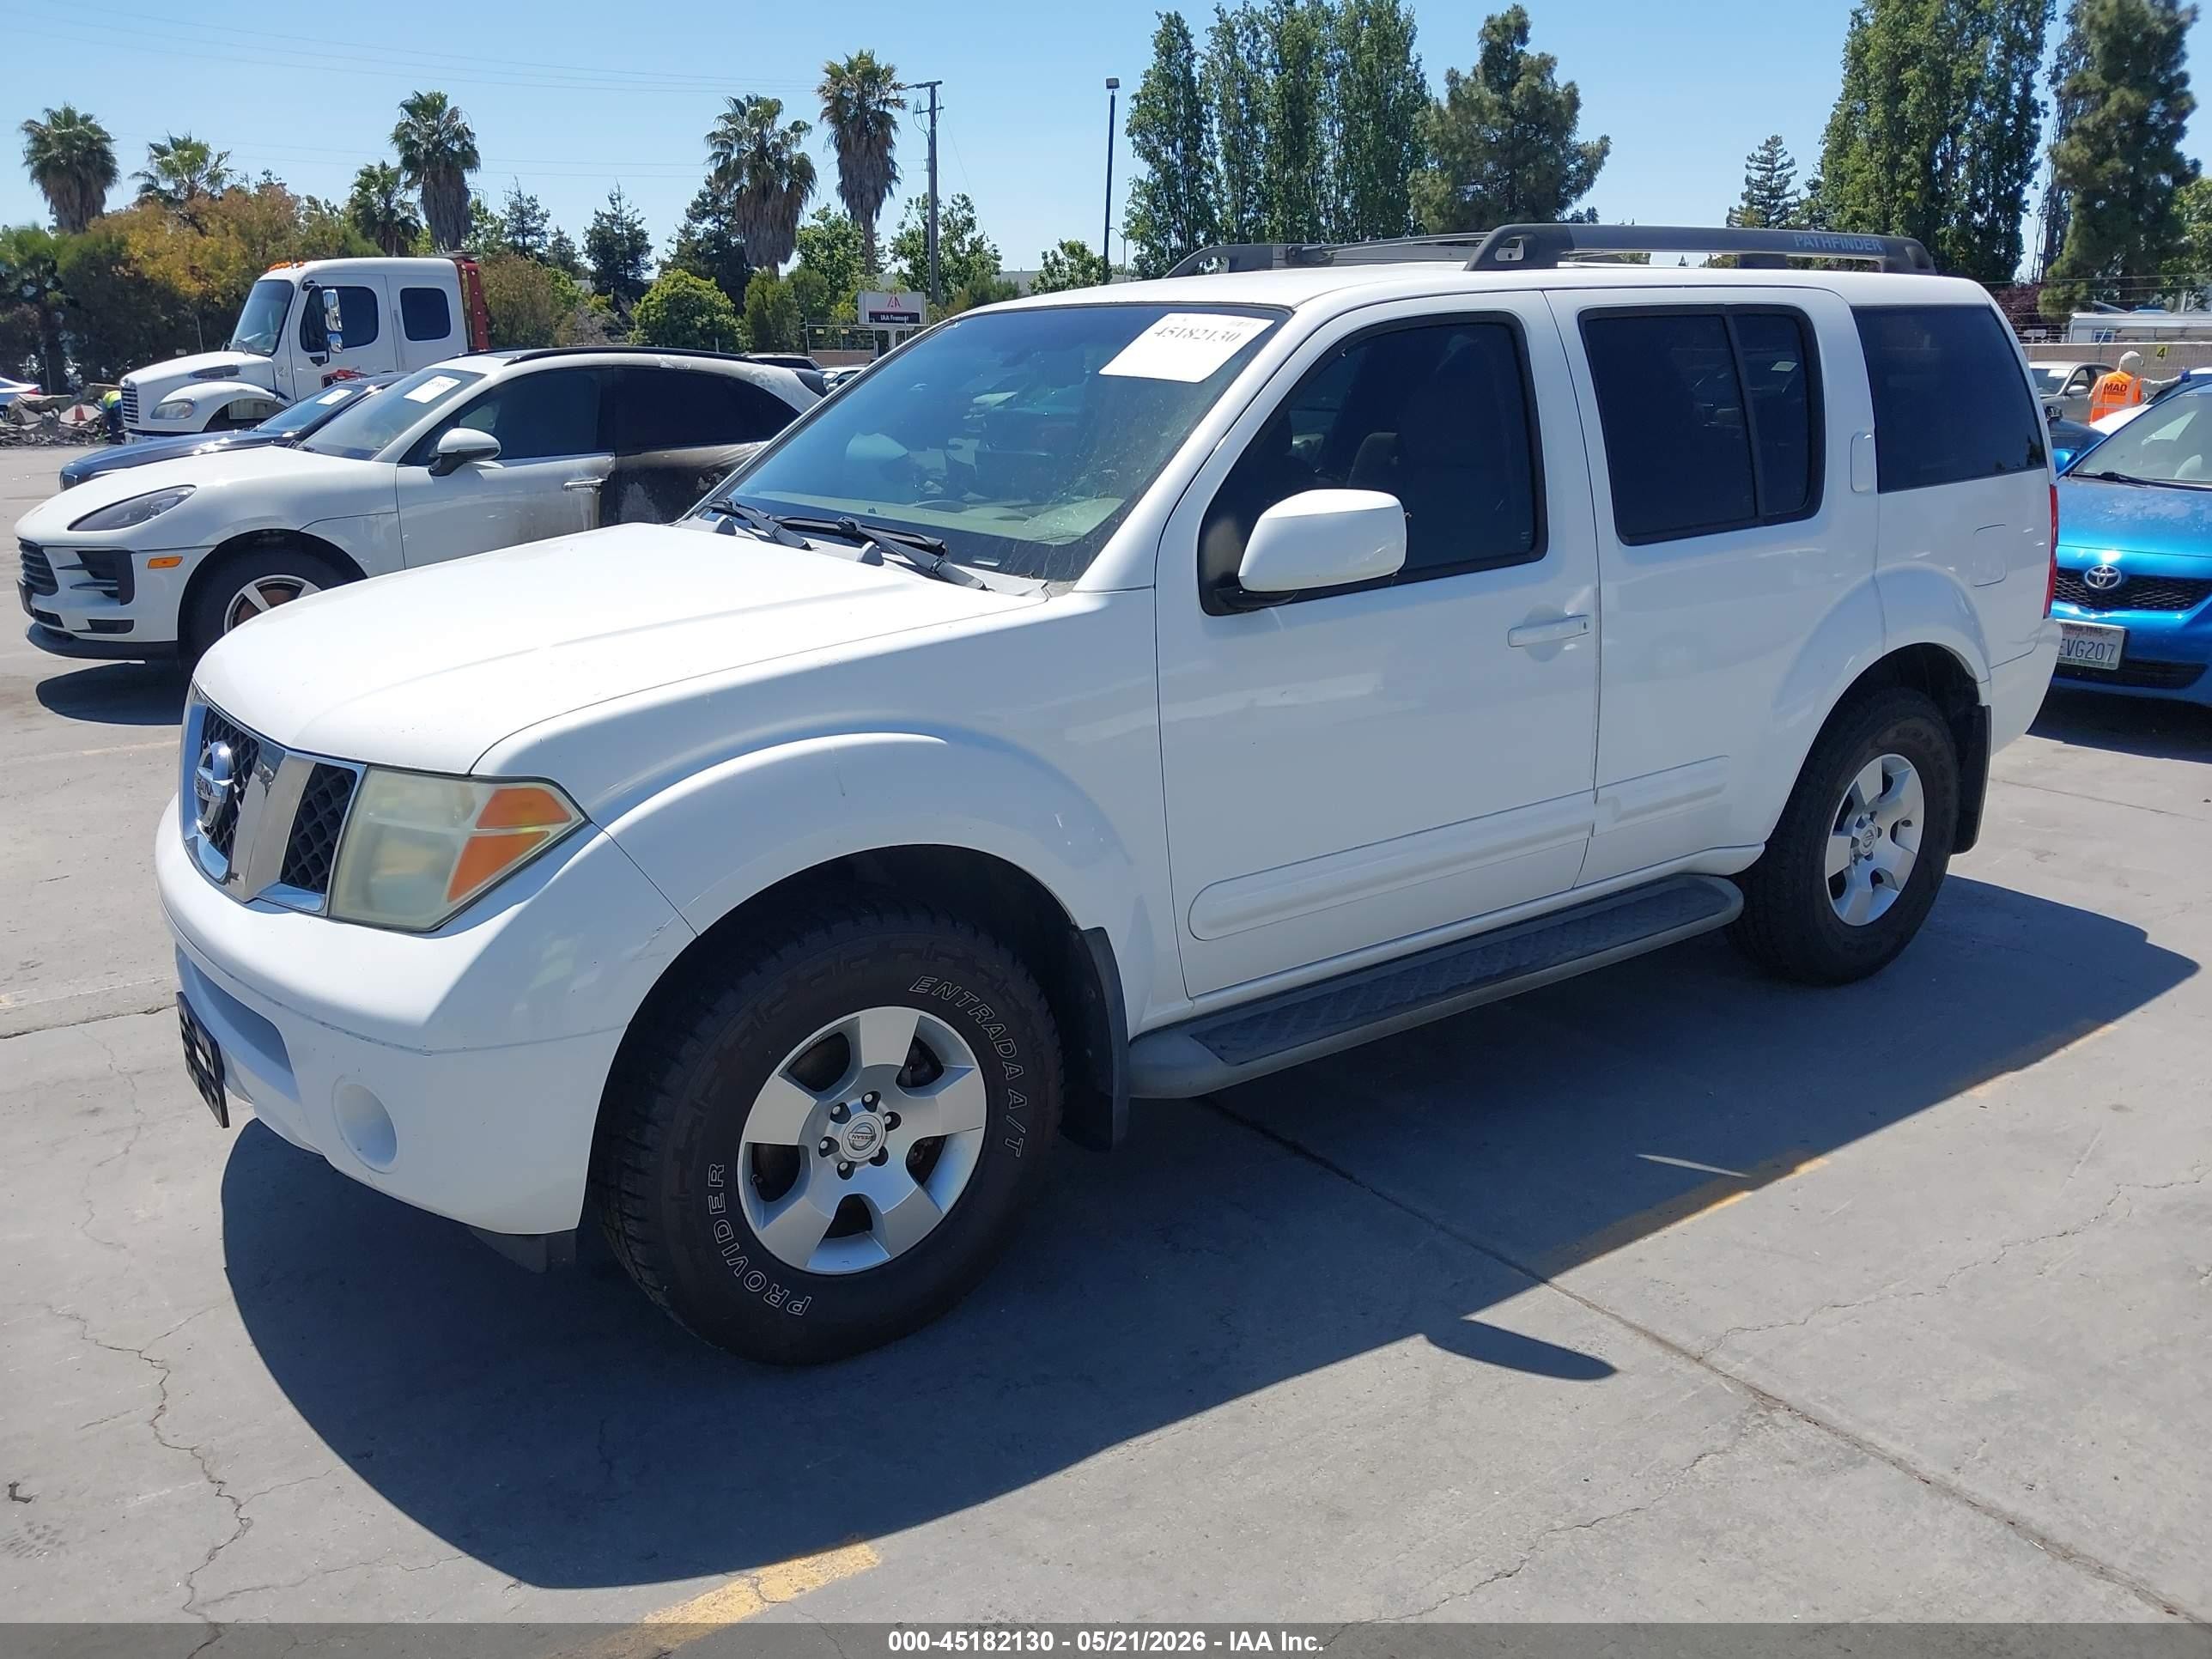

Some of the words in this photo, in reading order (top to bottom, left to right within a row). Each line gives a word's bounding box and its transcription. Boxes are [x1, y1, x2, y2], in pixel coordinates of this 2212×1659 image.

[1793, 234, 1884, 252] PATHFINDER
[1153, 325, 1243, 343] 45182130
[2156, 347, 2166, 360] 4
[2104, 383, 2128, 392] MAD
[908, 975, 1025, 1080] ENTRADA
[1002, 1090, 1030, 1158] A/T
[708, 1162, 813, 1317] PROVIDER
